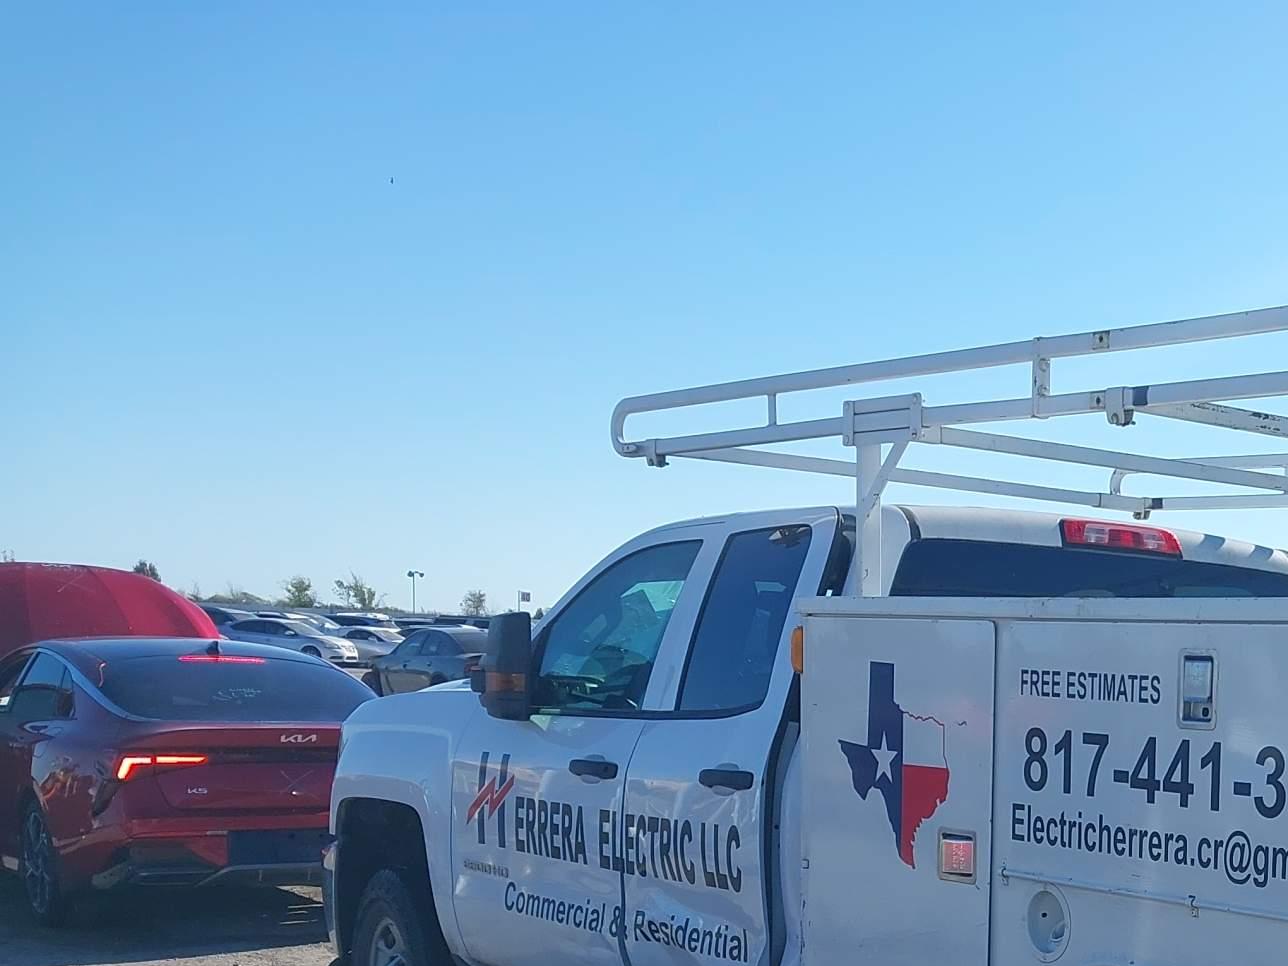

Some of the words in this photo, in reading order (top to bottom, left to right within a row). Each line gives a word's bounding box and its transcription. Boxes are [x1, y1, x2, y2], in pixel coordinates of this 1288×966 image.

[1020, 668, 1062, 698] FREE
[1066, 671, 1162, 705] ESTIMATES
[280, 733, 317, 743] KIA
[599, 808, 696, 885] ELECTRIC
[700, 822, 743, 893] LLC
[504, 881, 606, 934] Commercial
[609, 905, 628, 941] &
[634, 910, 748, 963] Residential
